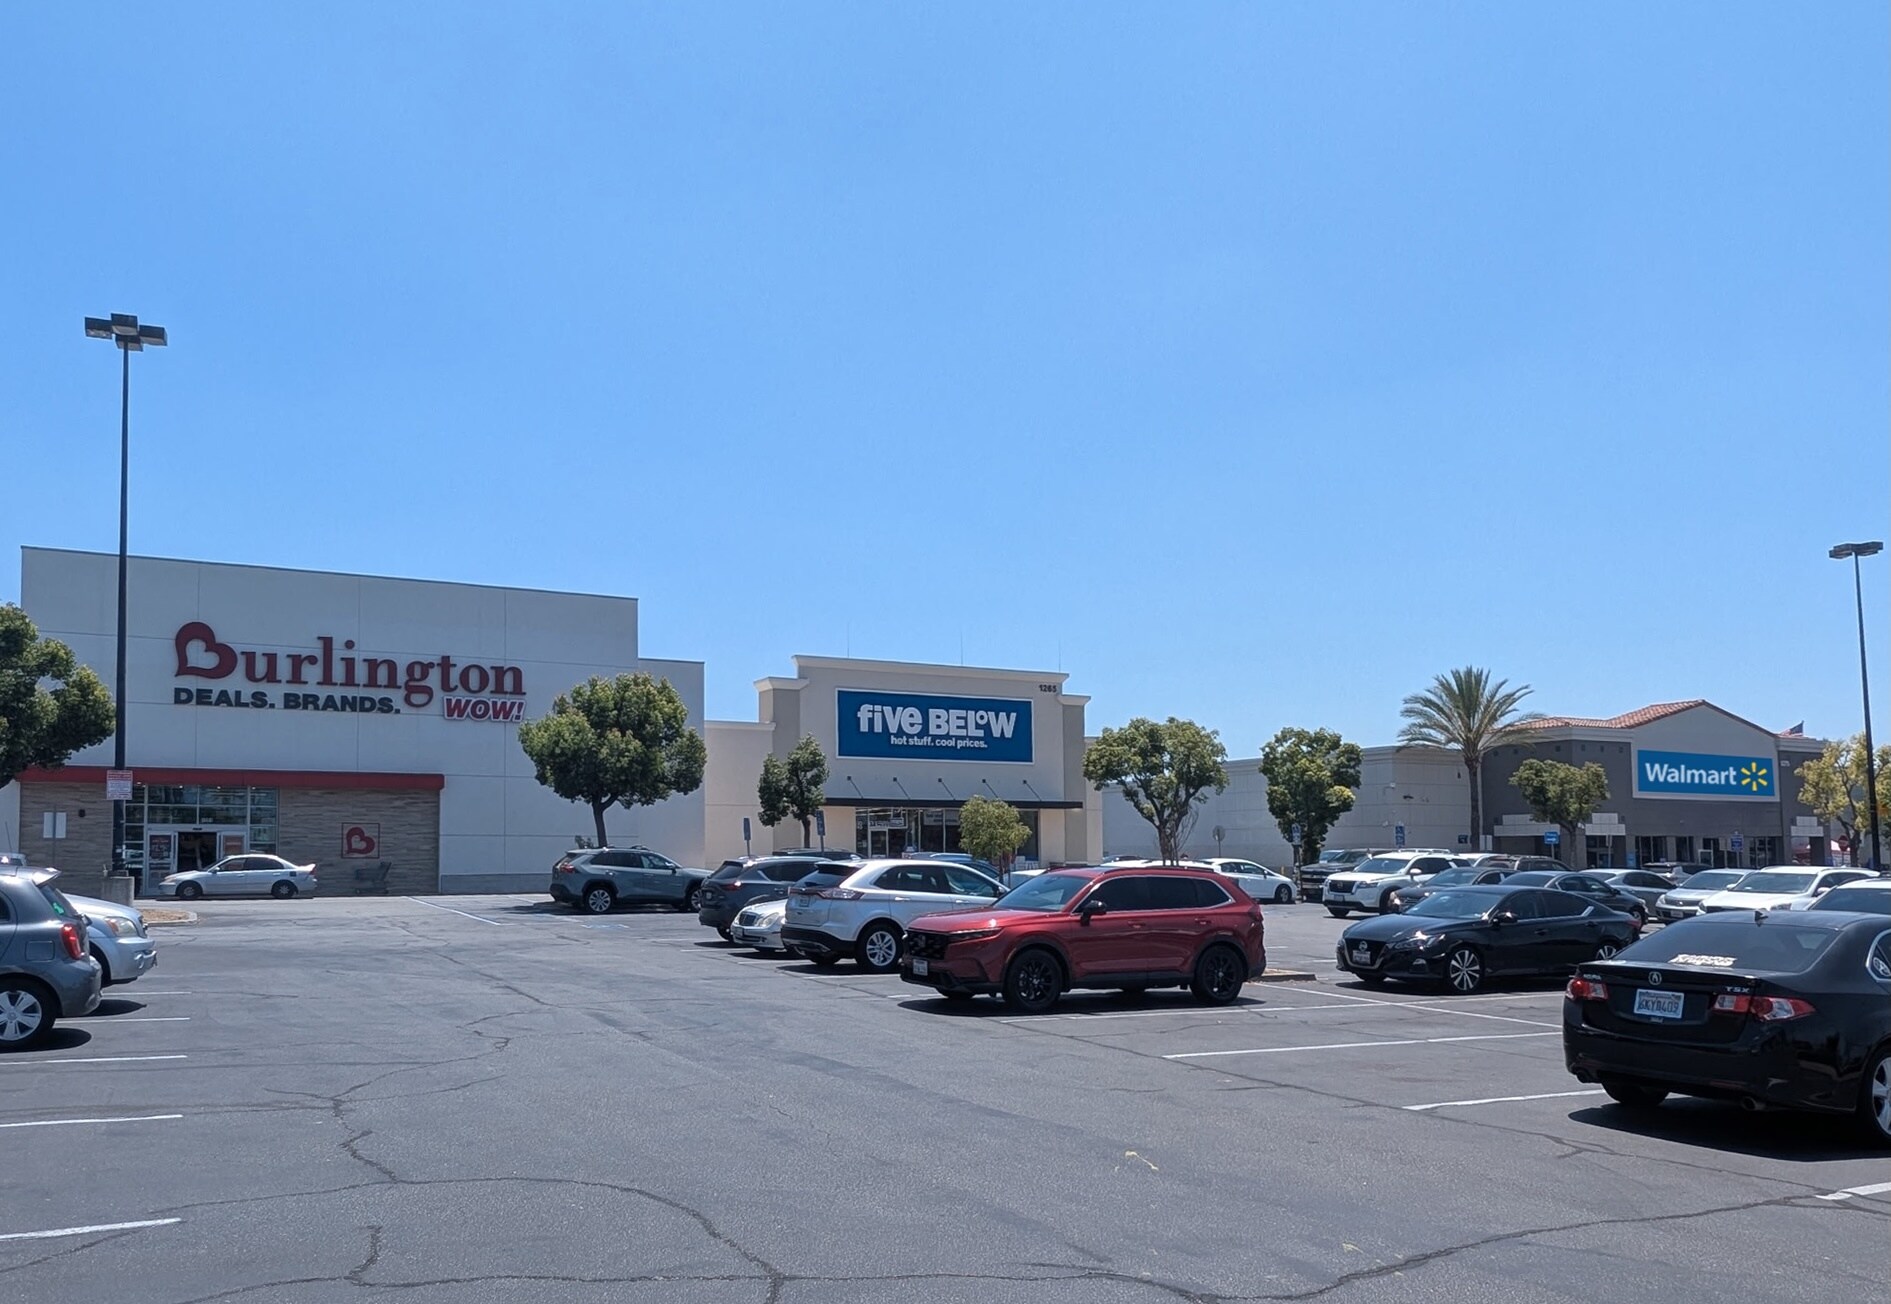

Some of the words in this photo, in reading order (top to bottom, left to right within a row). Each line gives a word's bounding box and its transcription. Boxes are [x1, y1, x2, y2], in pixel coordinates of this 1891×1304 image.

[175, 621, 527, 708] Burlington
[174, 687, 276, 709] DEALS.
[283, 692, 401, 714] BRANDS.
[444, 696, 526, 722] WOW!
[857, 703, 923, 735] five
[890, 735, 907, 745] hot
[908, 736, 934, 747] stuff.
[935, 737, 956, 748] cool
[957, 738, 988, 749] prices.
[1645, 762, 1737, 785] Walmart
